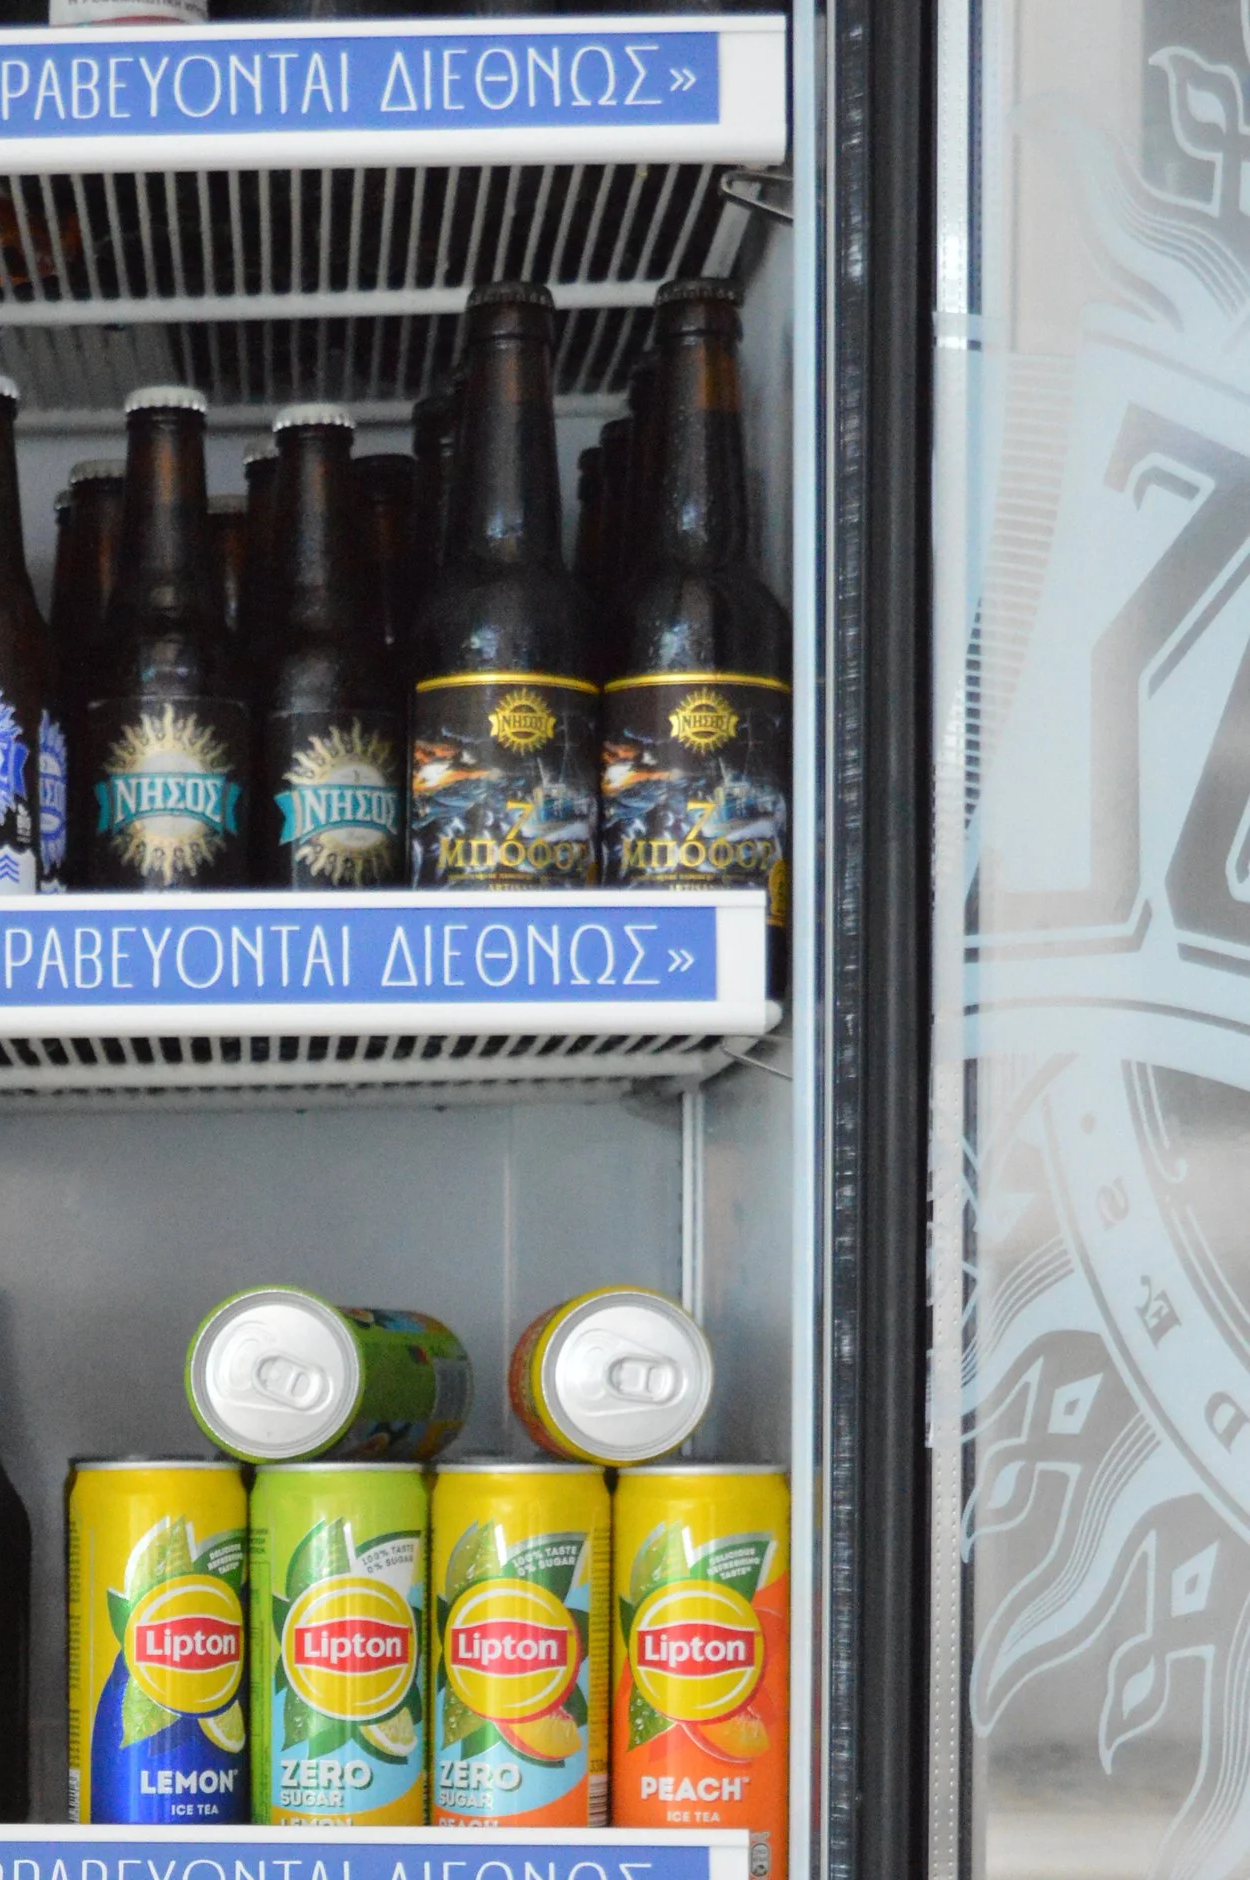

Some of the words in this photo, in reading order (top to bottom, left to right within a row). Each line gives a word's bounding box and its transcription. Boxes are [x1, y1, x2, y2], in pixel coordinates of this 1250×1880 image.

[379, 45, 699, 113] ΔΙΕΘΝΩΣ»
[113, 778, 224, 822] ΝΗΣΟΣ
[302, 788, 398, 834] ΝΗΣΟΣ
[506, 800, 535, 840] 7
[686, 800, 716, 840] 7
[381, 922, 695, 988] ΔΙΕΘΝΩΣ»
[145, 1630, 238, 1661] Lipton
[304, 1631, 403, 1665] Lipton
[458, 1632, 559, 1666] Lipton
[644, 1634, 747, 1668] Lipton
[139, 1769, 236, 1795] LEMON
[280, 1759, 373, 1790] ZERO
[438, 1761, 523, 1792] ZERO
[640, 1776, 743, 1802] PEACH
[170, 1803, 194, 1817] ICE
[196, 1803, 220, 1817] TEA
[280, 1790, 345, 1808] SUGAR
[438, 1792, 494, 1811] SUGAR
[666, 1810, 690, 1823] ICE
[692, 1810, 721, 1823] TEA
